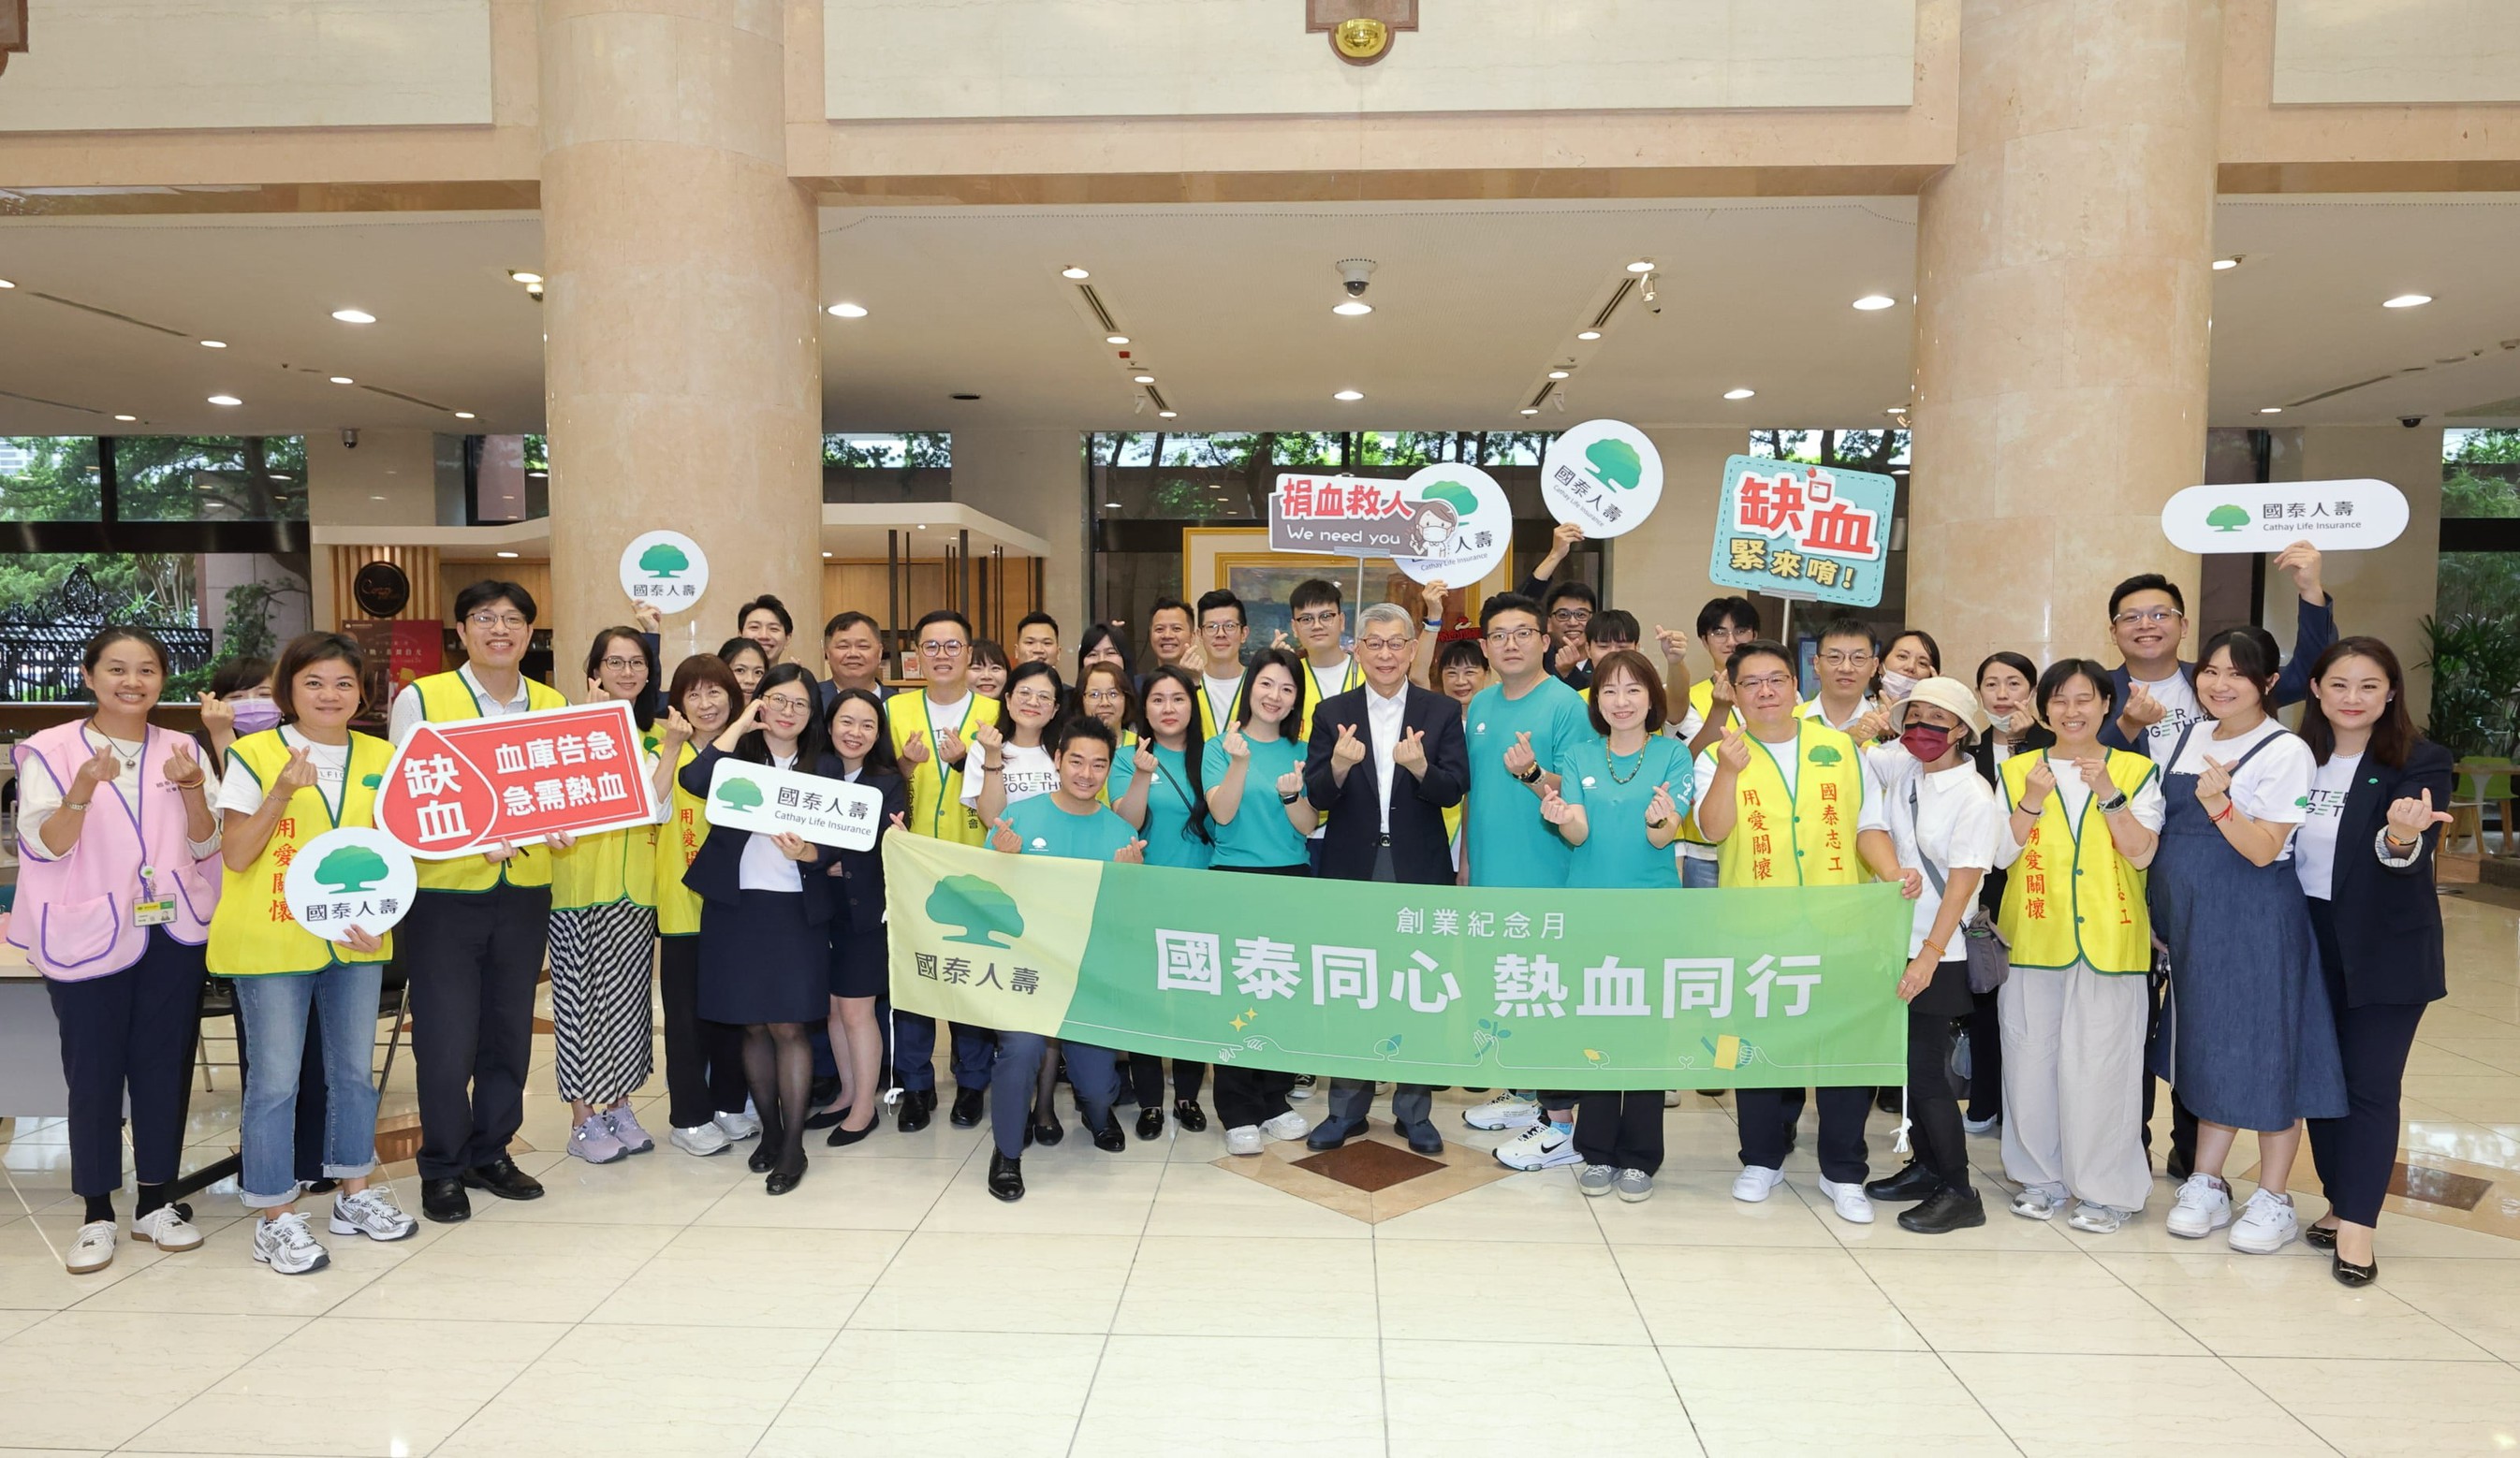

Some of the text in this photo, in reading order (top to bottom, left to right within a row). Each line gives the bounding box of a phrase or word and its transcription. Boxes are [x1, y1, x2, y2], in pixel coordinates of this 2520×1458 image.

[1283, 478, 1414, 518] 捐血救人
[1554, 465, 1623, 522] 國泰人壽
[2263, 501, 2354, 519] 國泰人壽
[1740, 476, 1874, 555] 缺血
[2264, 520, 2362, 532] Cathay Life Insurance
[1286, 524, 1401, 546] We need you
[1420, 552, 1488, 572] Cathay Life Insurance
[634, 584, 696, 597] 國泰人壽
[494, 730, 618, 775] 血庫告急
[403, 752, 472, 843] 缺血
[503, 771, 628, 817] 急需熱血
[777, 786, 869, 820] 國泰人壽
[1004, 781, 1062, 795] TOGETH
[774, 809, 872, 836] Cathay Life Insurance
[1742, 789, 1773, 881] 用愛關懷
[1820, 782, 1843, 871] 國泰志工
[306, 898, 398, 923] 國泰人壽
[1396, 906, 1565, 940] 創業紀念月
[915, 952, 1040, 995] 國泰人壽
[1155, 927, 1823, 1019] 國泰同心 熱血同行
